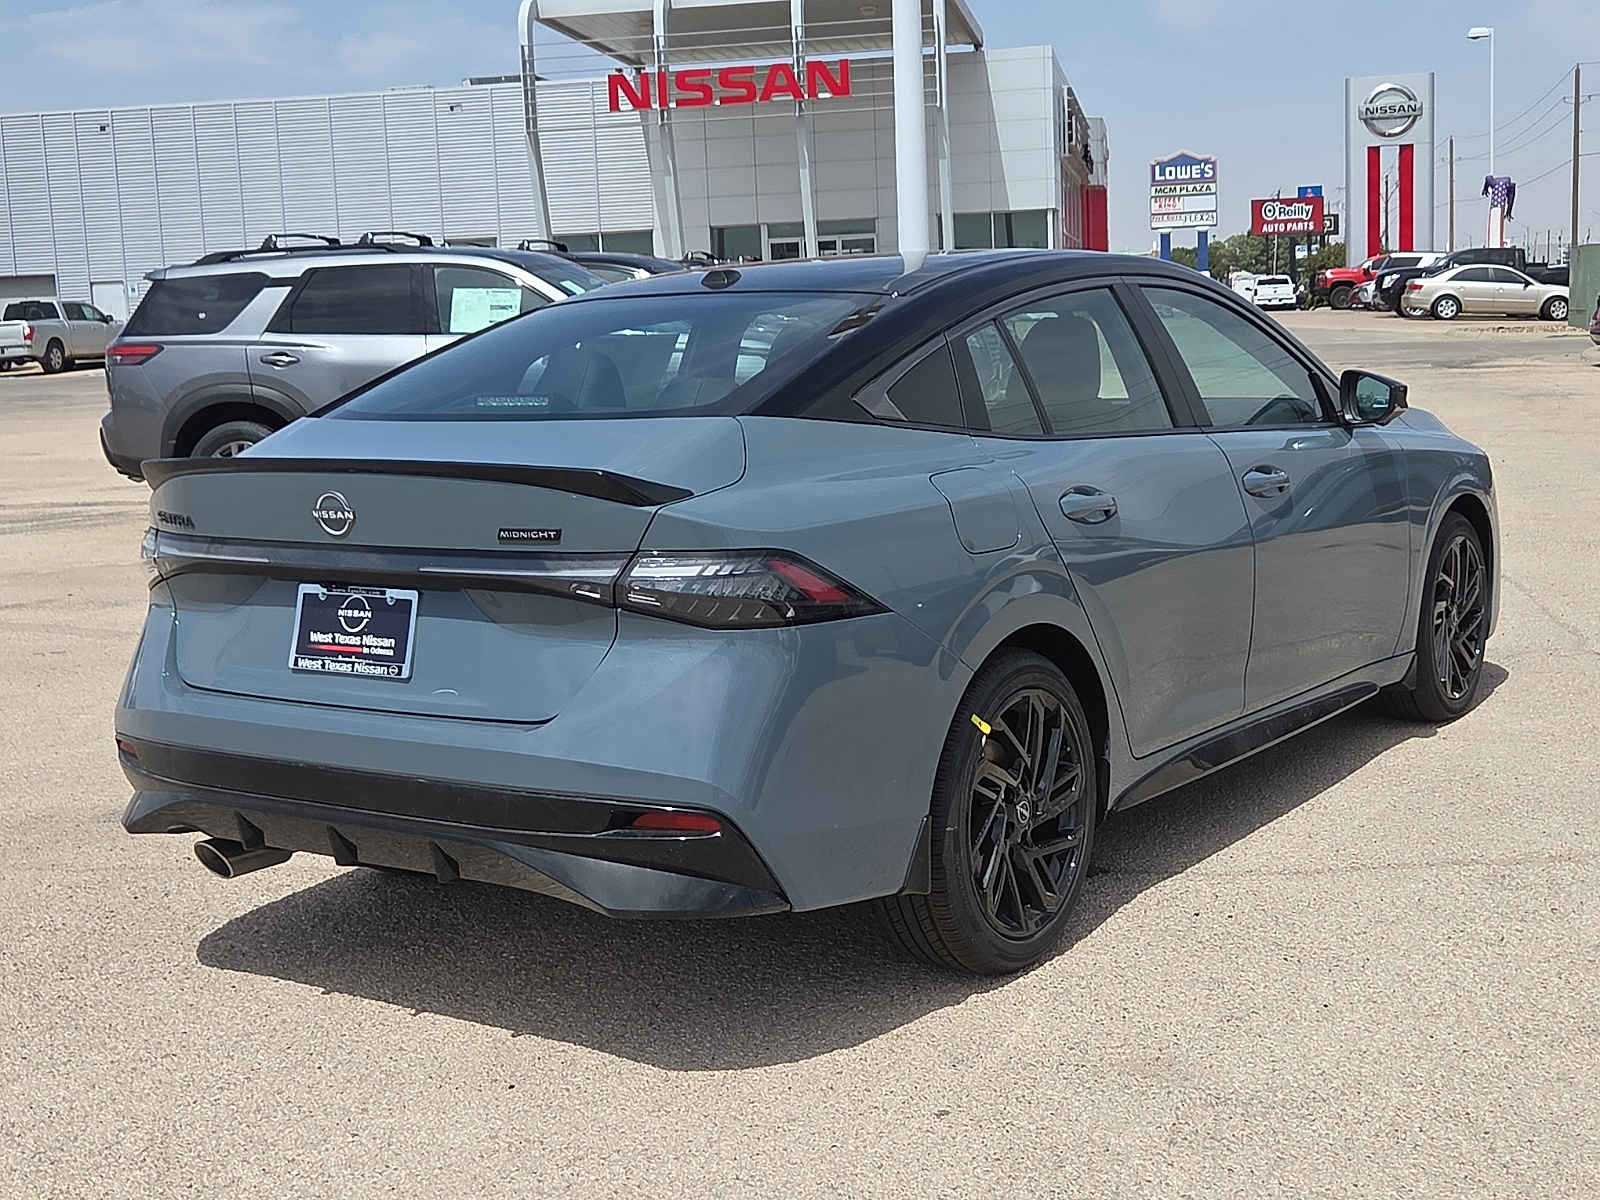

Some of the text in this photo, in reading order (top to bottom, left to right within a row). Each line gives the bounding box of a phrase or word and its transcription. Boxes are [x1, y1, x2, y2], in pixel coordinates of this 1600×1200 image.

[608, 59, 850, 112] NISSAN
[1365, 103, 1417, 116] NISSAN
[1155, 162, 1214, 181] LOWE'S
[1155, 184, 1212, 195] MCM PLAZA
[1262, 202, 1313, 219] O'Reilly
[1262, 221, 1314, 233] AUTO PARTS
[312, 509, 354, 521] NISSAN
[499, 530, 557, 539] MIDNIGHT
[337, 608, 372, 619] NISSAN
[310, 631, 395, 647] West Texas Nissan
[297, 657, 323, 669] West
[324, 659, 352, 672] Texas
[353, 662, 388, 675] Nissan
